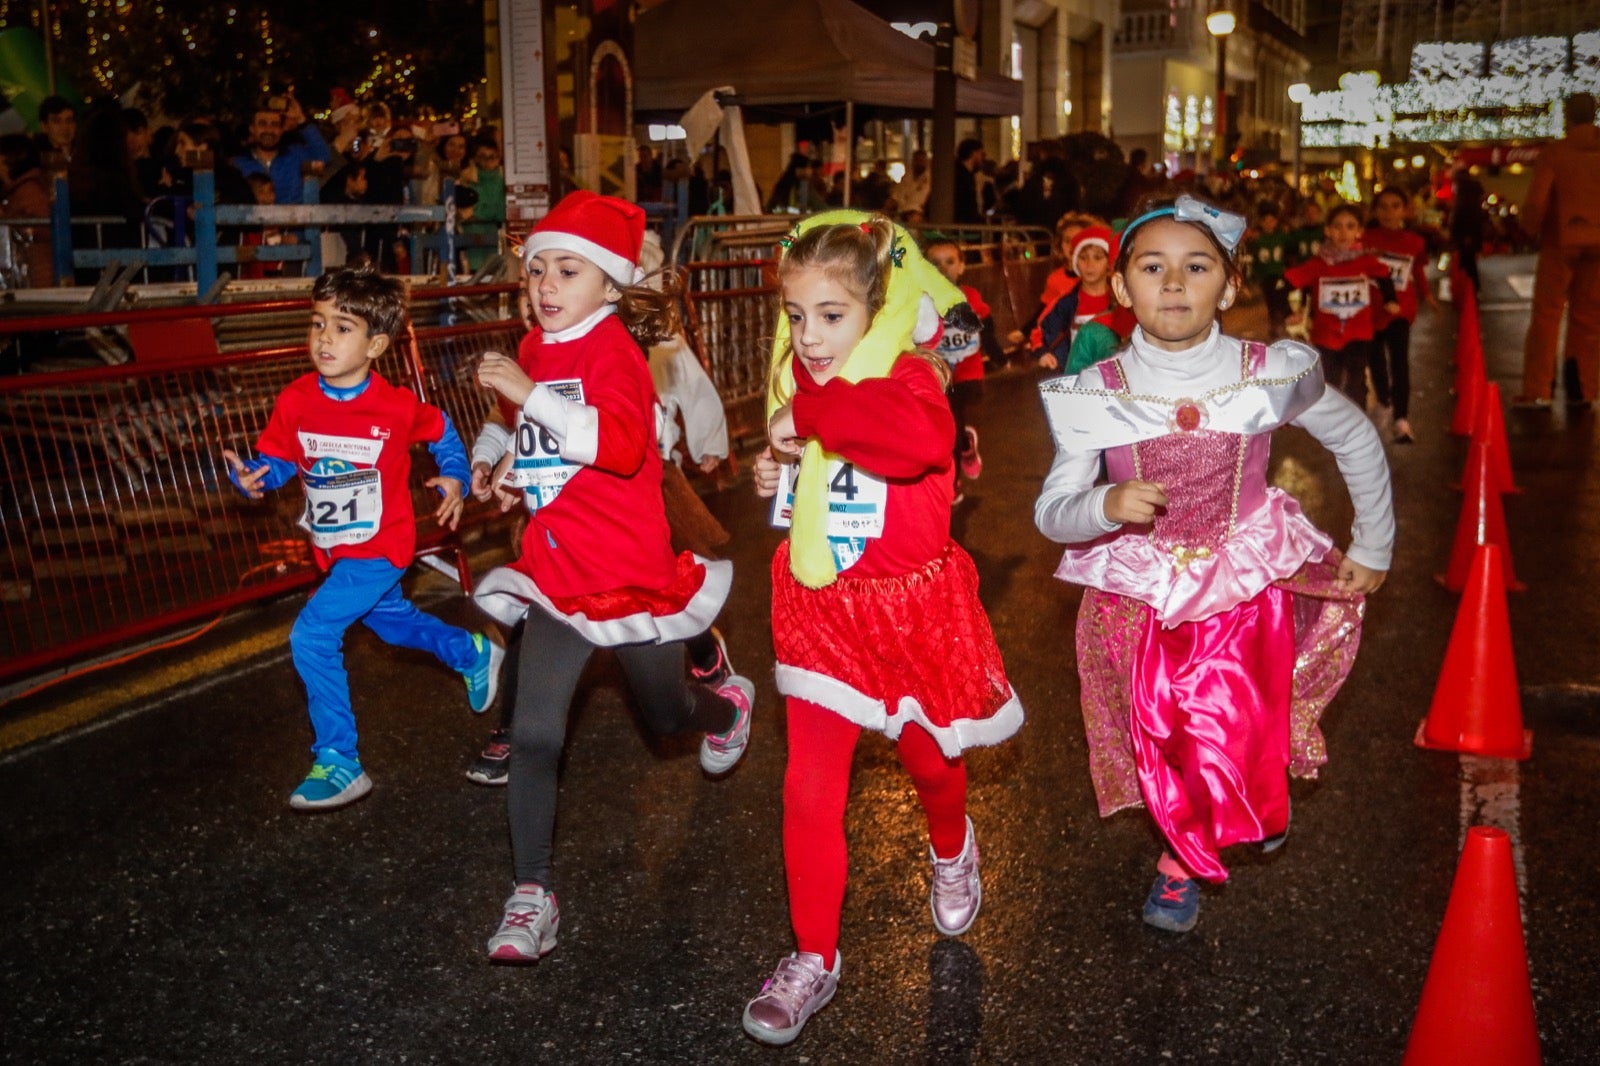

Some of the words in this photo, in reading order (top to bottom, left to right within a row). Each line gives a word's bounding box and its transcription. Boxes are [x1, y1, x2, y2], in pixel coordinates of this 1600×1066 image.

[1331, 290, 1361, 305] 212
[307, 438, 318, 452] 30
[343, 443, 371, 452] NOCTURNA
[516, 423, 559, 457] 06
[827, 463, 858, 500] 4
